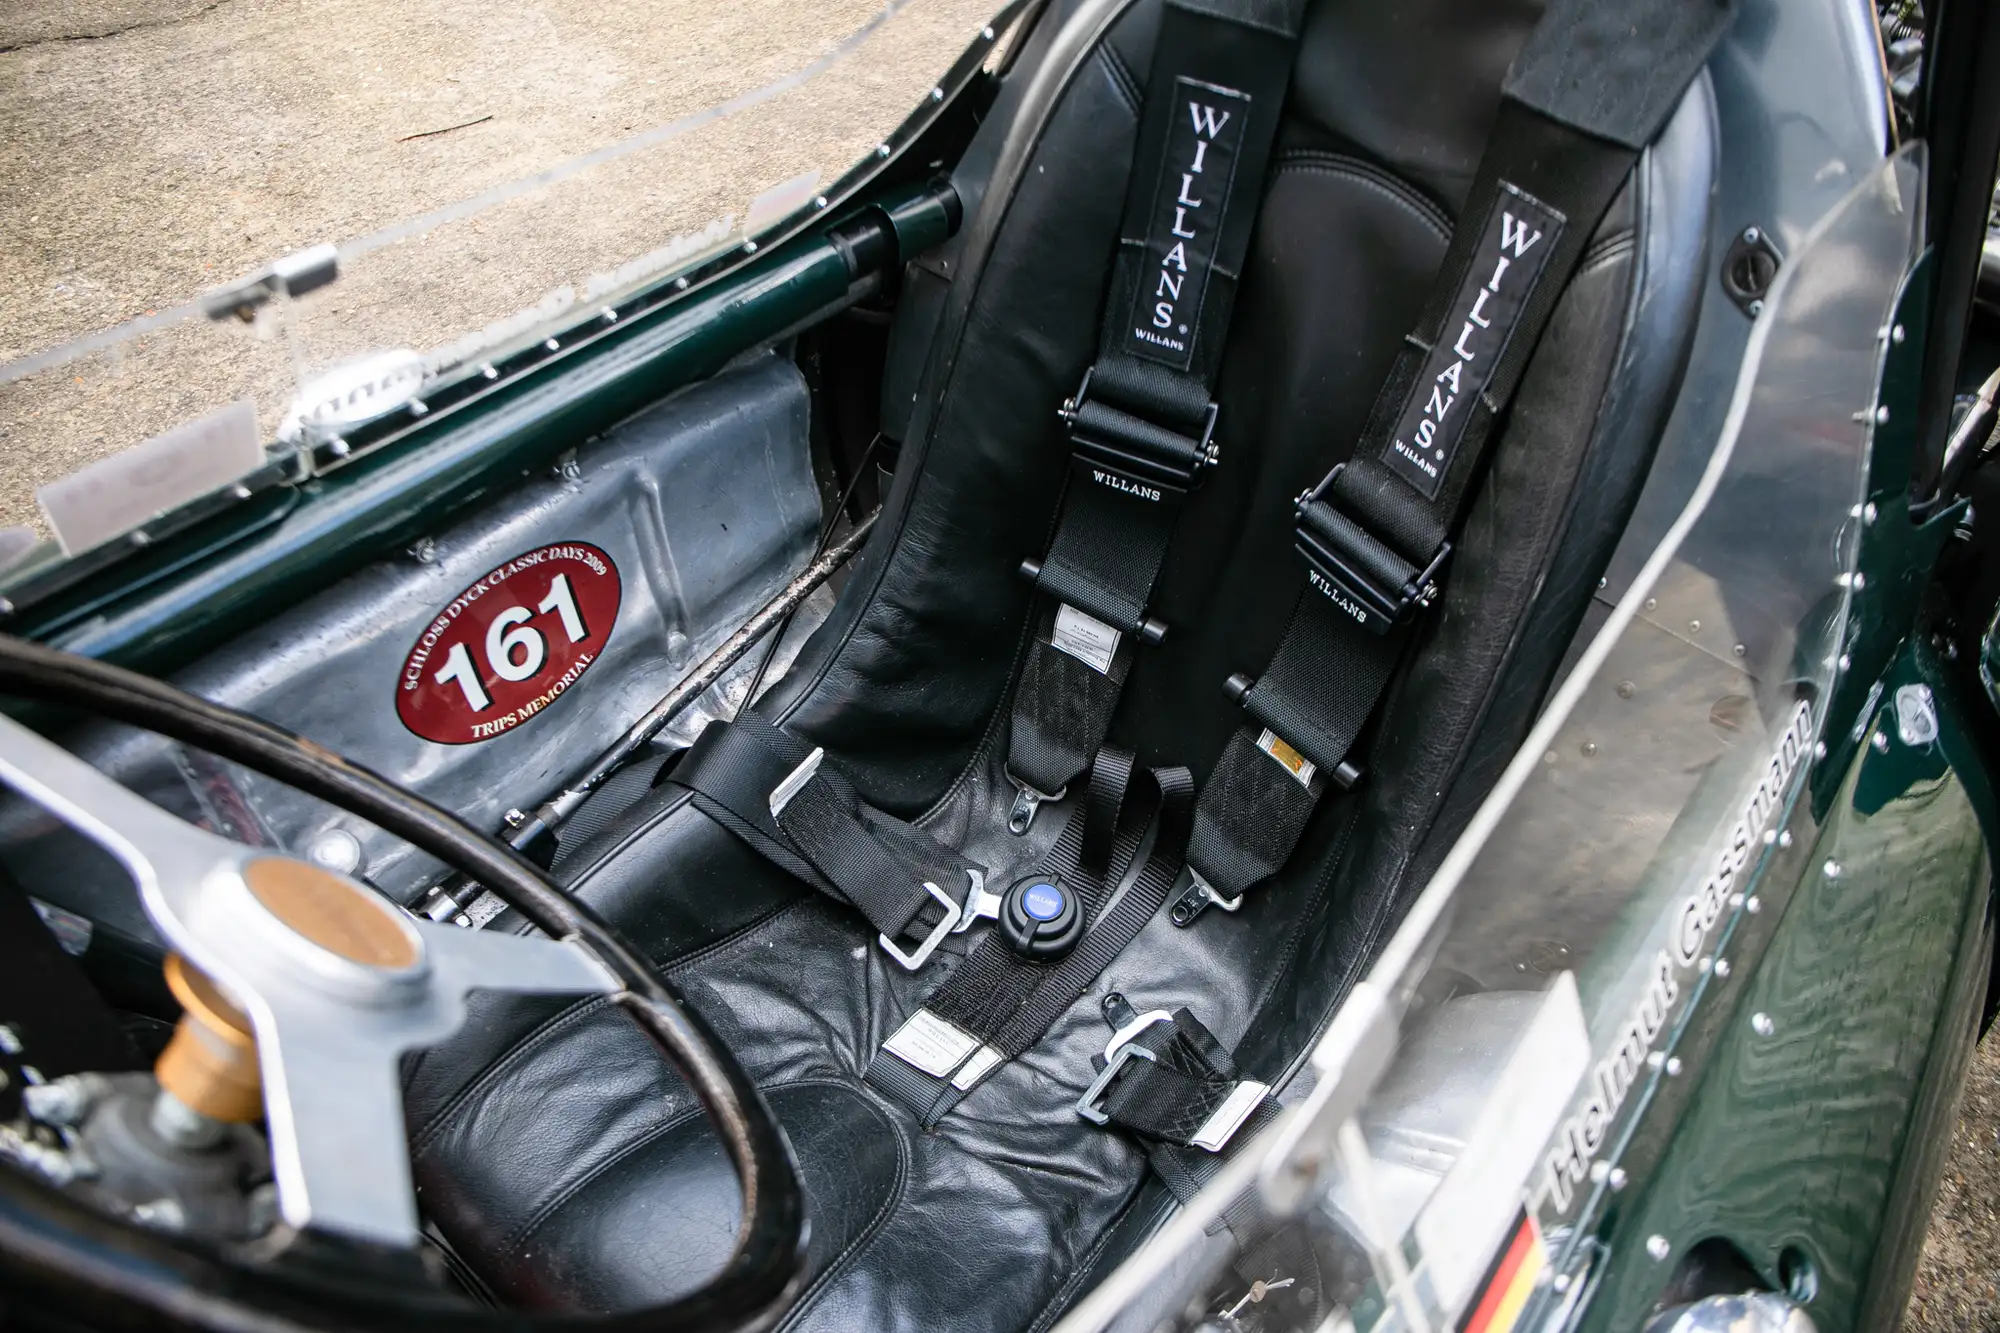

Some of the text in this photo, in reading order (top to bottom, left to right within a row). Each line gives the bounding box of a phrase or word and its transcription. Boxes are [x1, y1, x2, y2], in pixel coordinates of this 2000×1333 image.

[1152, 101, 1231, 329] WILLANS
[1135, 327, 1184, 352] WILLANS
[1414, 211, 1541, 450] WILLANS
[1093, 469, 1160, 501] WILLANS
[1395, 438, 1437, 478] WILLANS
[404, 546, 608, 690] SCHLOSS DYCK CLASSIC DAYS 2009
[434, 572, 587, 713] 161
[1309, 570, 1367, 623] WILLANS
[471, 652, 594, 739] TRIPS MEMORIAL
[1545, 699, 1813, 1213] Helmut Gassmann
